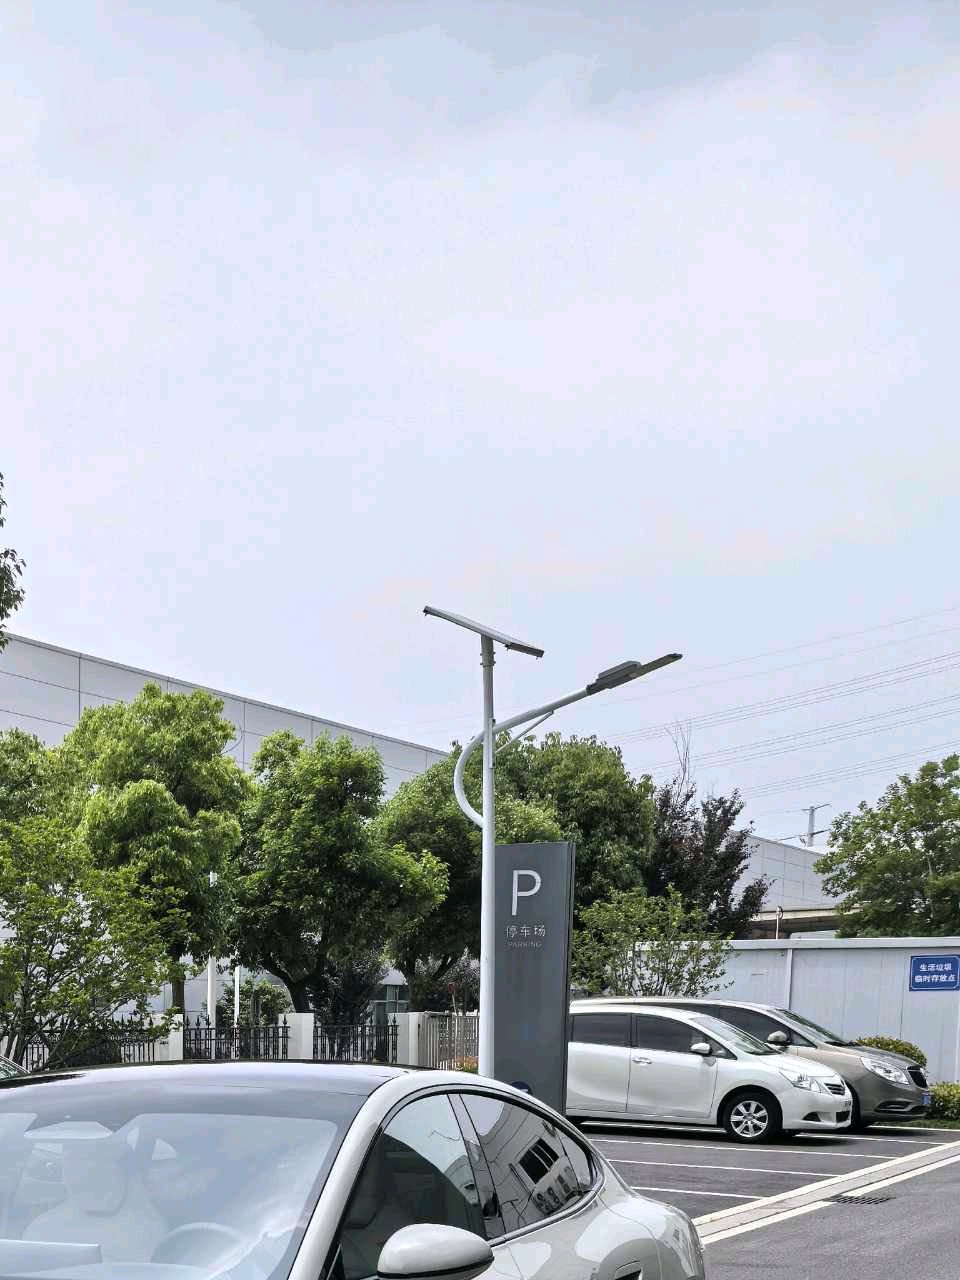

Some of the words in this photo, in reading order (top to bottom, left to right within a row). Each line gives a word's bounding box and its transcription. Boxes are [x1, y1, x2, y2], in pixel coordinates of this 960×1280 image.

[511, 869, 541, 916] P
[505, 924, 546, 938] 停车场
[507, 940, 542, 950] PARKING
[919, 962, 952, 972] 生活垃圾
[914, 974, 956, 983] 临时存放点
